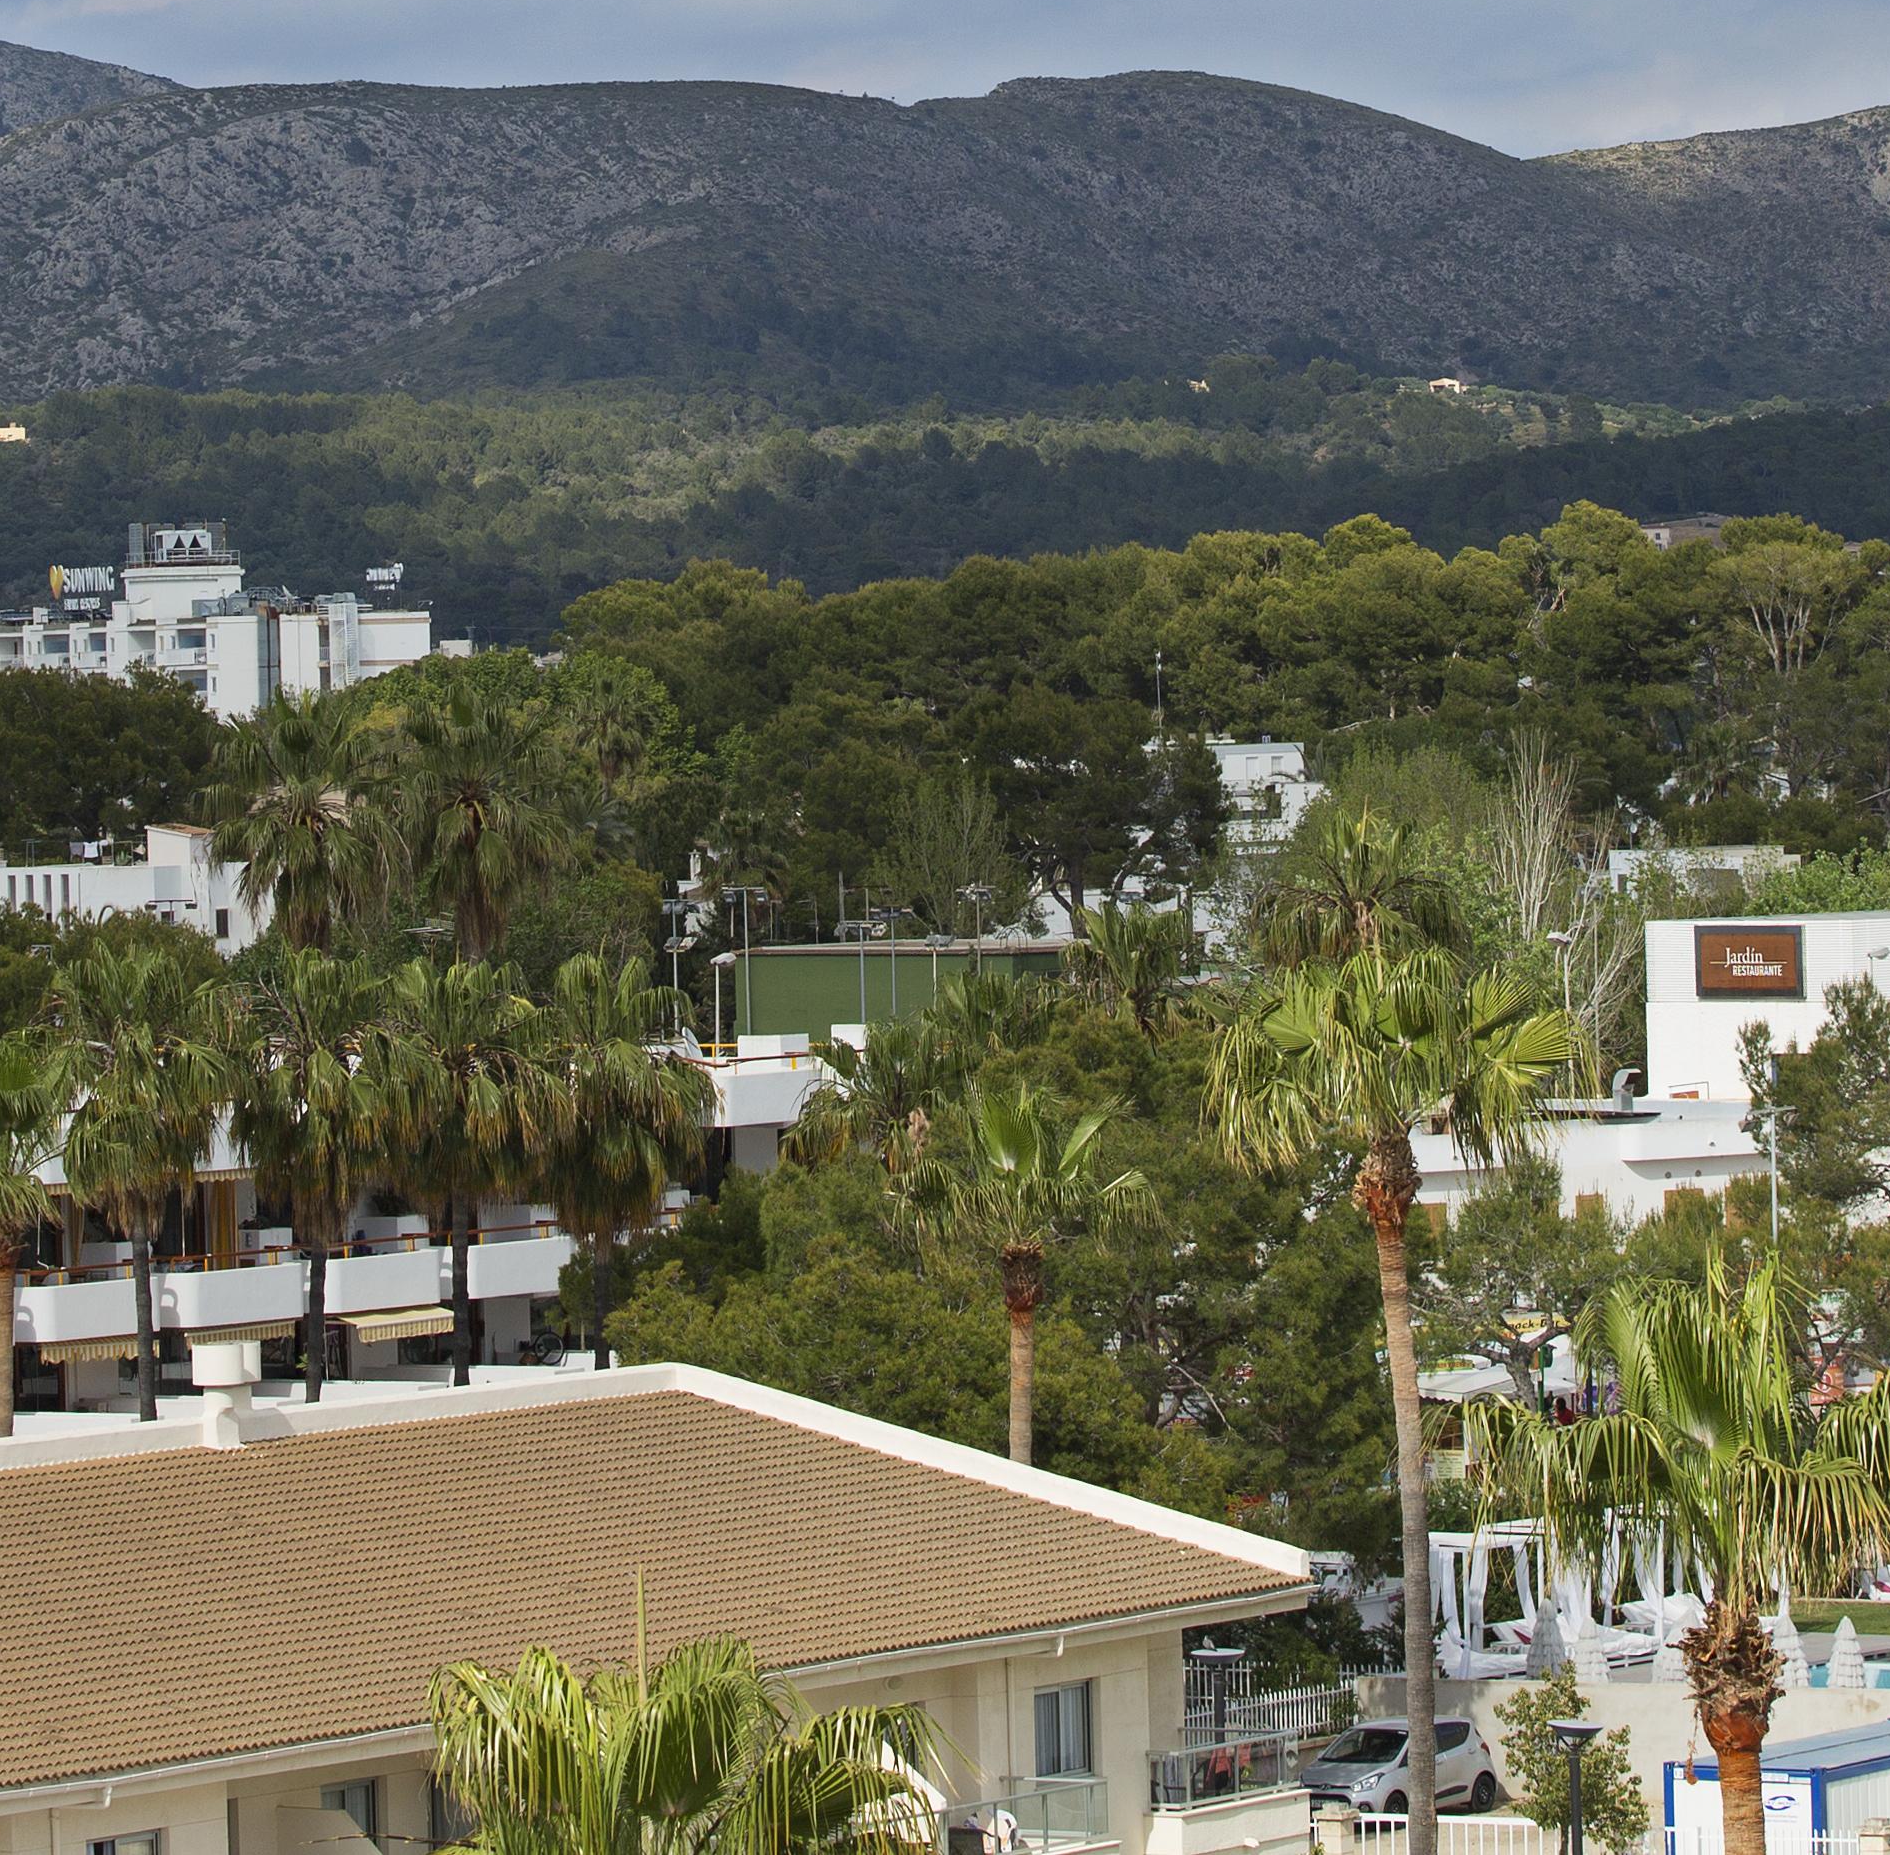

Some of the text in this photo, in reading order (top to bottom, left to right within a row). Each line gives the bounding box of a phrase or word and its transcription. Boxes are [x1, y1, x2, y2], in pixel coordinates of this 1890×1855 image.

[63, 566, 115, 593] SUNWING
[1724, 946, 1763, 968] Jardín
[1732, 964, 1783, 976] RESTAURANTE
